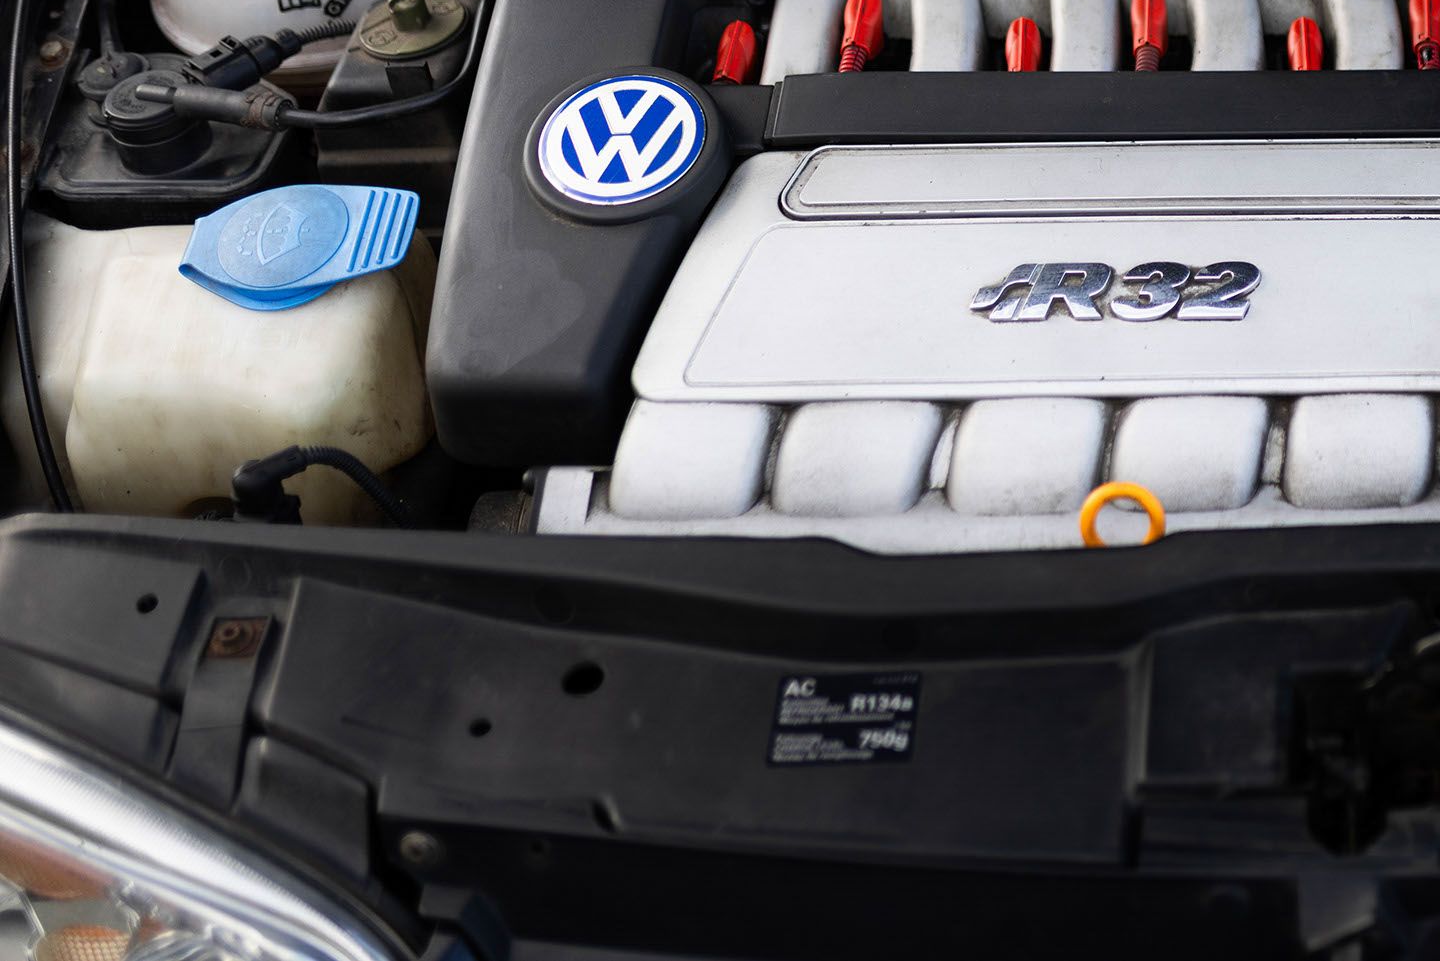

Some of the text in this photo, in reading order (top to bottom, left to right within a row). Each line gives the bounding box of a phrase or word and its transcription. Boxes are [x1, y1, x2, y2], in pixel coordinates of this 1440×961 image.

[550, 80, 695, 197] VW
[970, 261, 1262, 322] R32
[784, 677, 817, 697] AC
[851, 694, 914, 712] R134a
